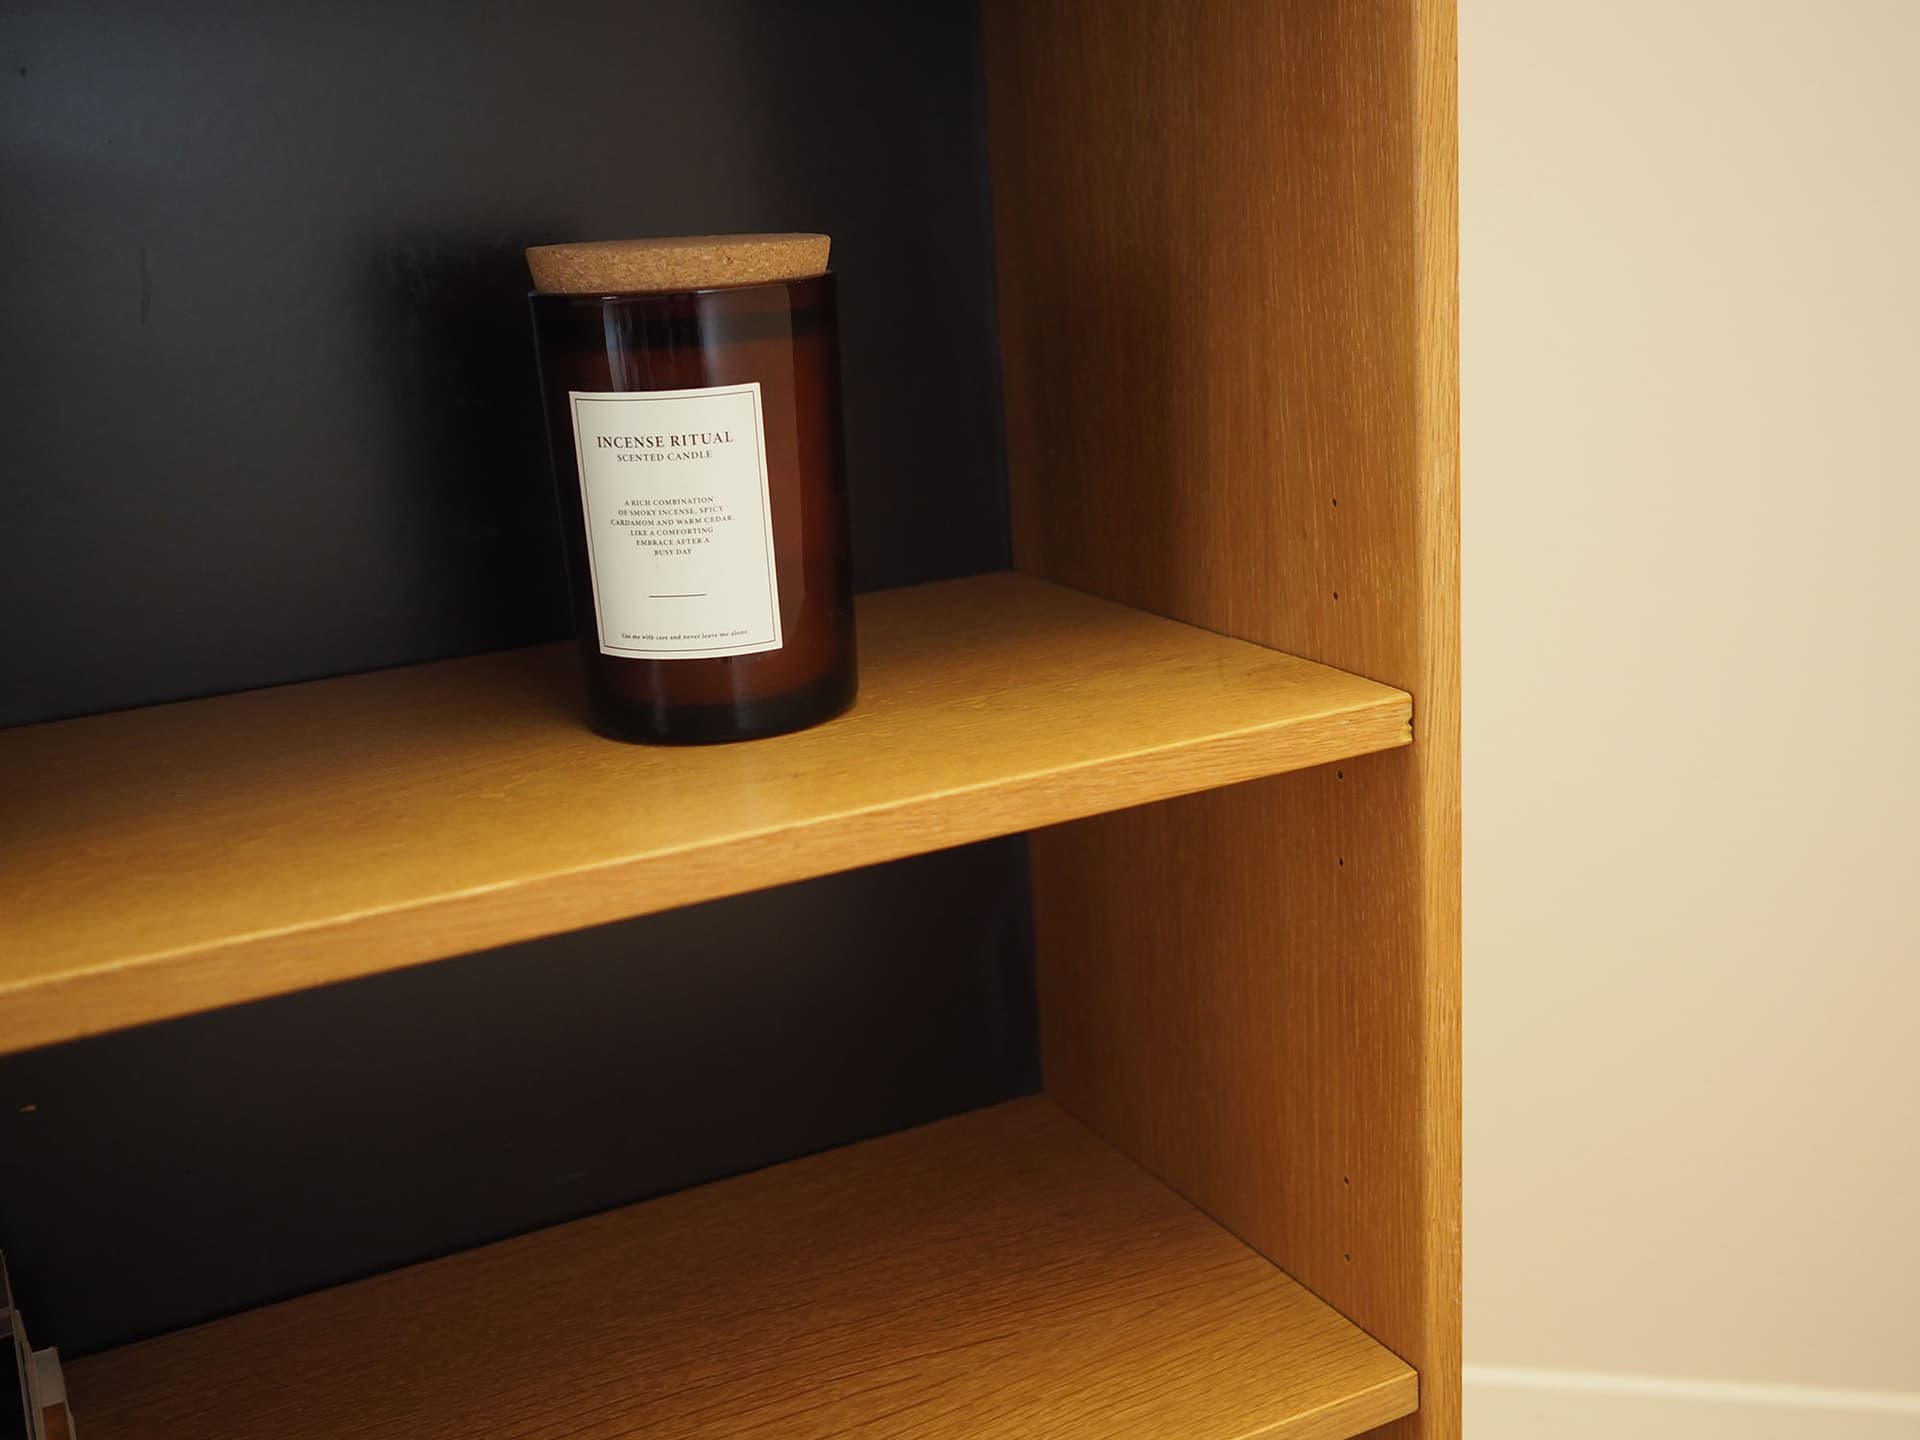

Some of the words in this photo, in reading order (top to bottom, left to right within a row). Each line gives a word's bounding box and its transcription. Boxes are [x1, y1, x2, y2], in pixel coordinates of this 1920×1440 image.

[596, 435, 666, 449] INCENSE
[670, 431, 734, 447] RITUAL
[616, 452, 665, 463] SCENTED
[667, 449, 713, 461] CANDLE
[631, 499, 651, 507] RICH
[652, 496, 714, 507] COMBINATION
[618, 509, 628, 517] OF
[629, 509, 657, 517] SMOKY
[699, 505, 724, 514] SPICY
[610, 518, 655, 527] CARDAMOM
[656, 519, 674, 527] AND
[676, 517, 702, 526] WARM
[630, 529, 647, 537] LIKE
[656, 526, 714, 537] COMFORTING
[636, 539, 674, 547] EMBRACE
[675, 537, 703, 546] AFTER
[654, 549, 674, 557] BUSY
[642, 633, 655, 641] with
[670, 633, 682, 641] and
